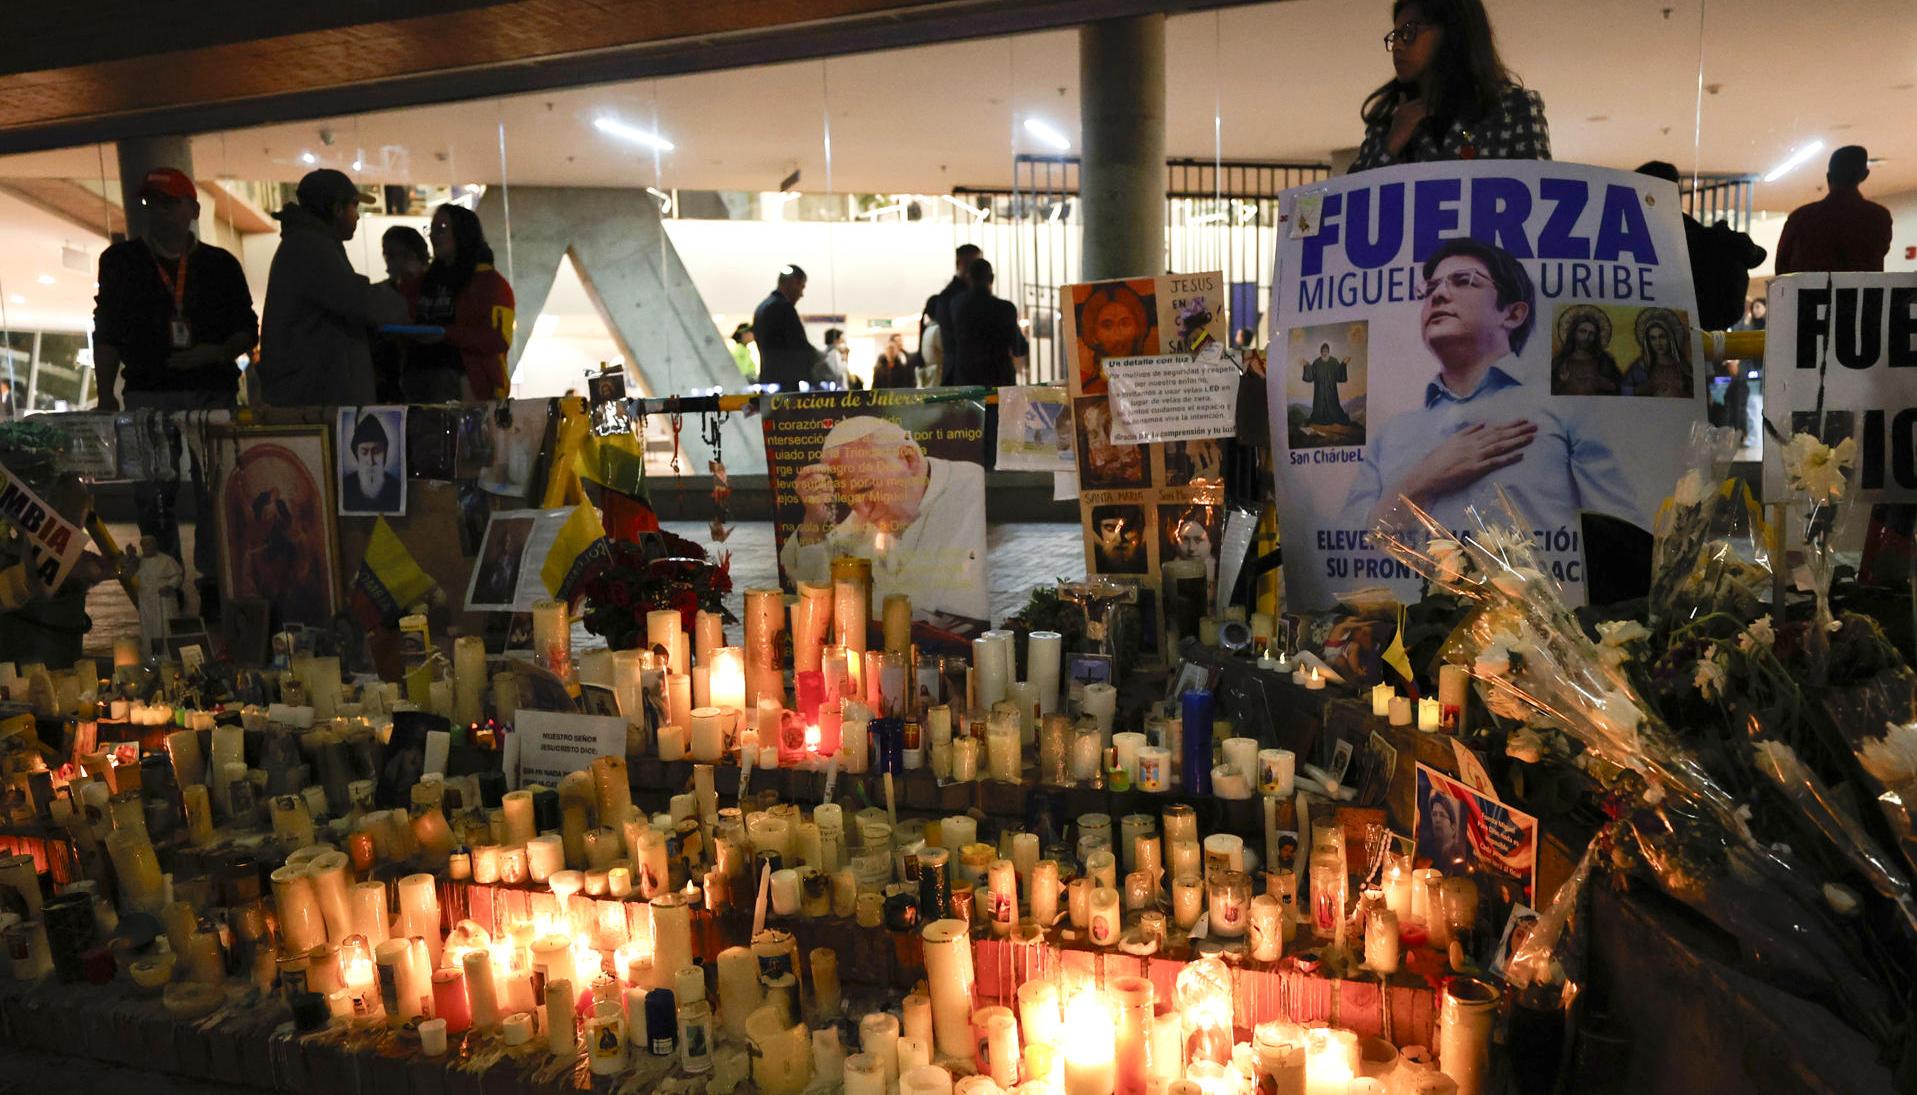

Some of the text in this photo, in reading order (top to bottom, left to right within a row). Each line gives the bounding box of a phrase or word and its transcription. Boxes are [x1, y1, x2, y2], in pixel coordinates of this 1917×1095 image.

[1301, 177, 1658, 277] FUERZA
[1169, 277, 1214, 293] JESUS
[1298, 263, 1655, 312] MIGUEL URIBE
[1173, 299, 1186, 309] EN
[841, 392, 861, 407] de
[778, 418, 824, 431] corazón
[1213, 425, 1221, 433] tu
[936, 428, 943, 440] ti
[946, 427, 983, 441] amigo
[1290, 451, 1310, 465] San
[1326, 557, 1348, 579] SU
[542, 732, 597, 744] NUESTRO SEÑOR
